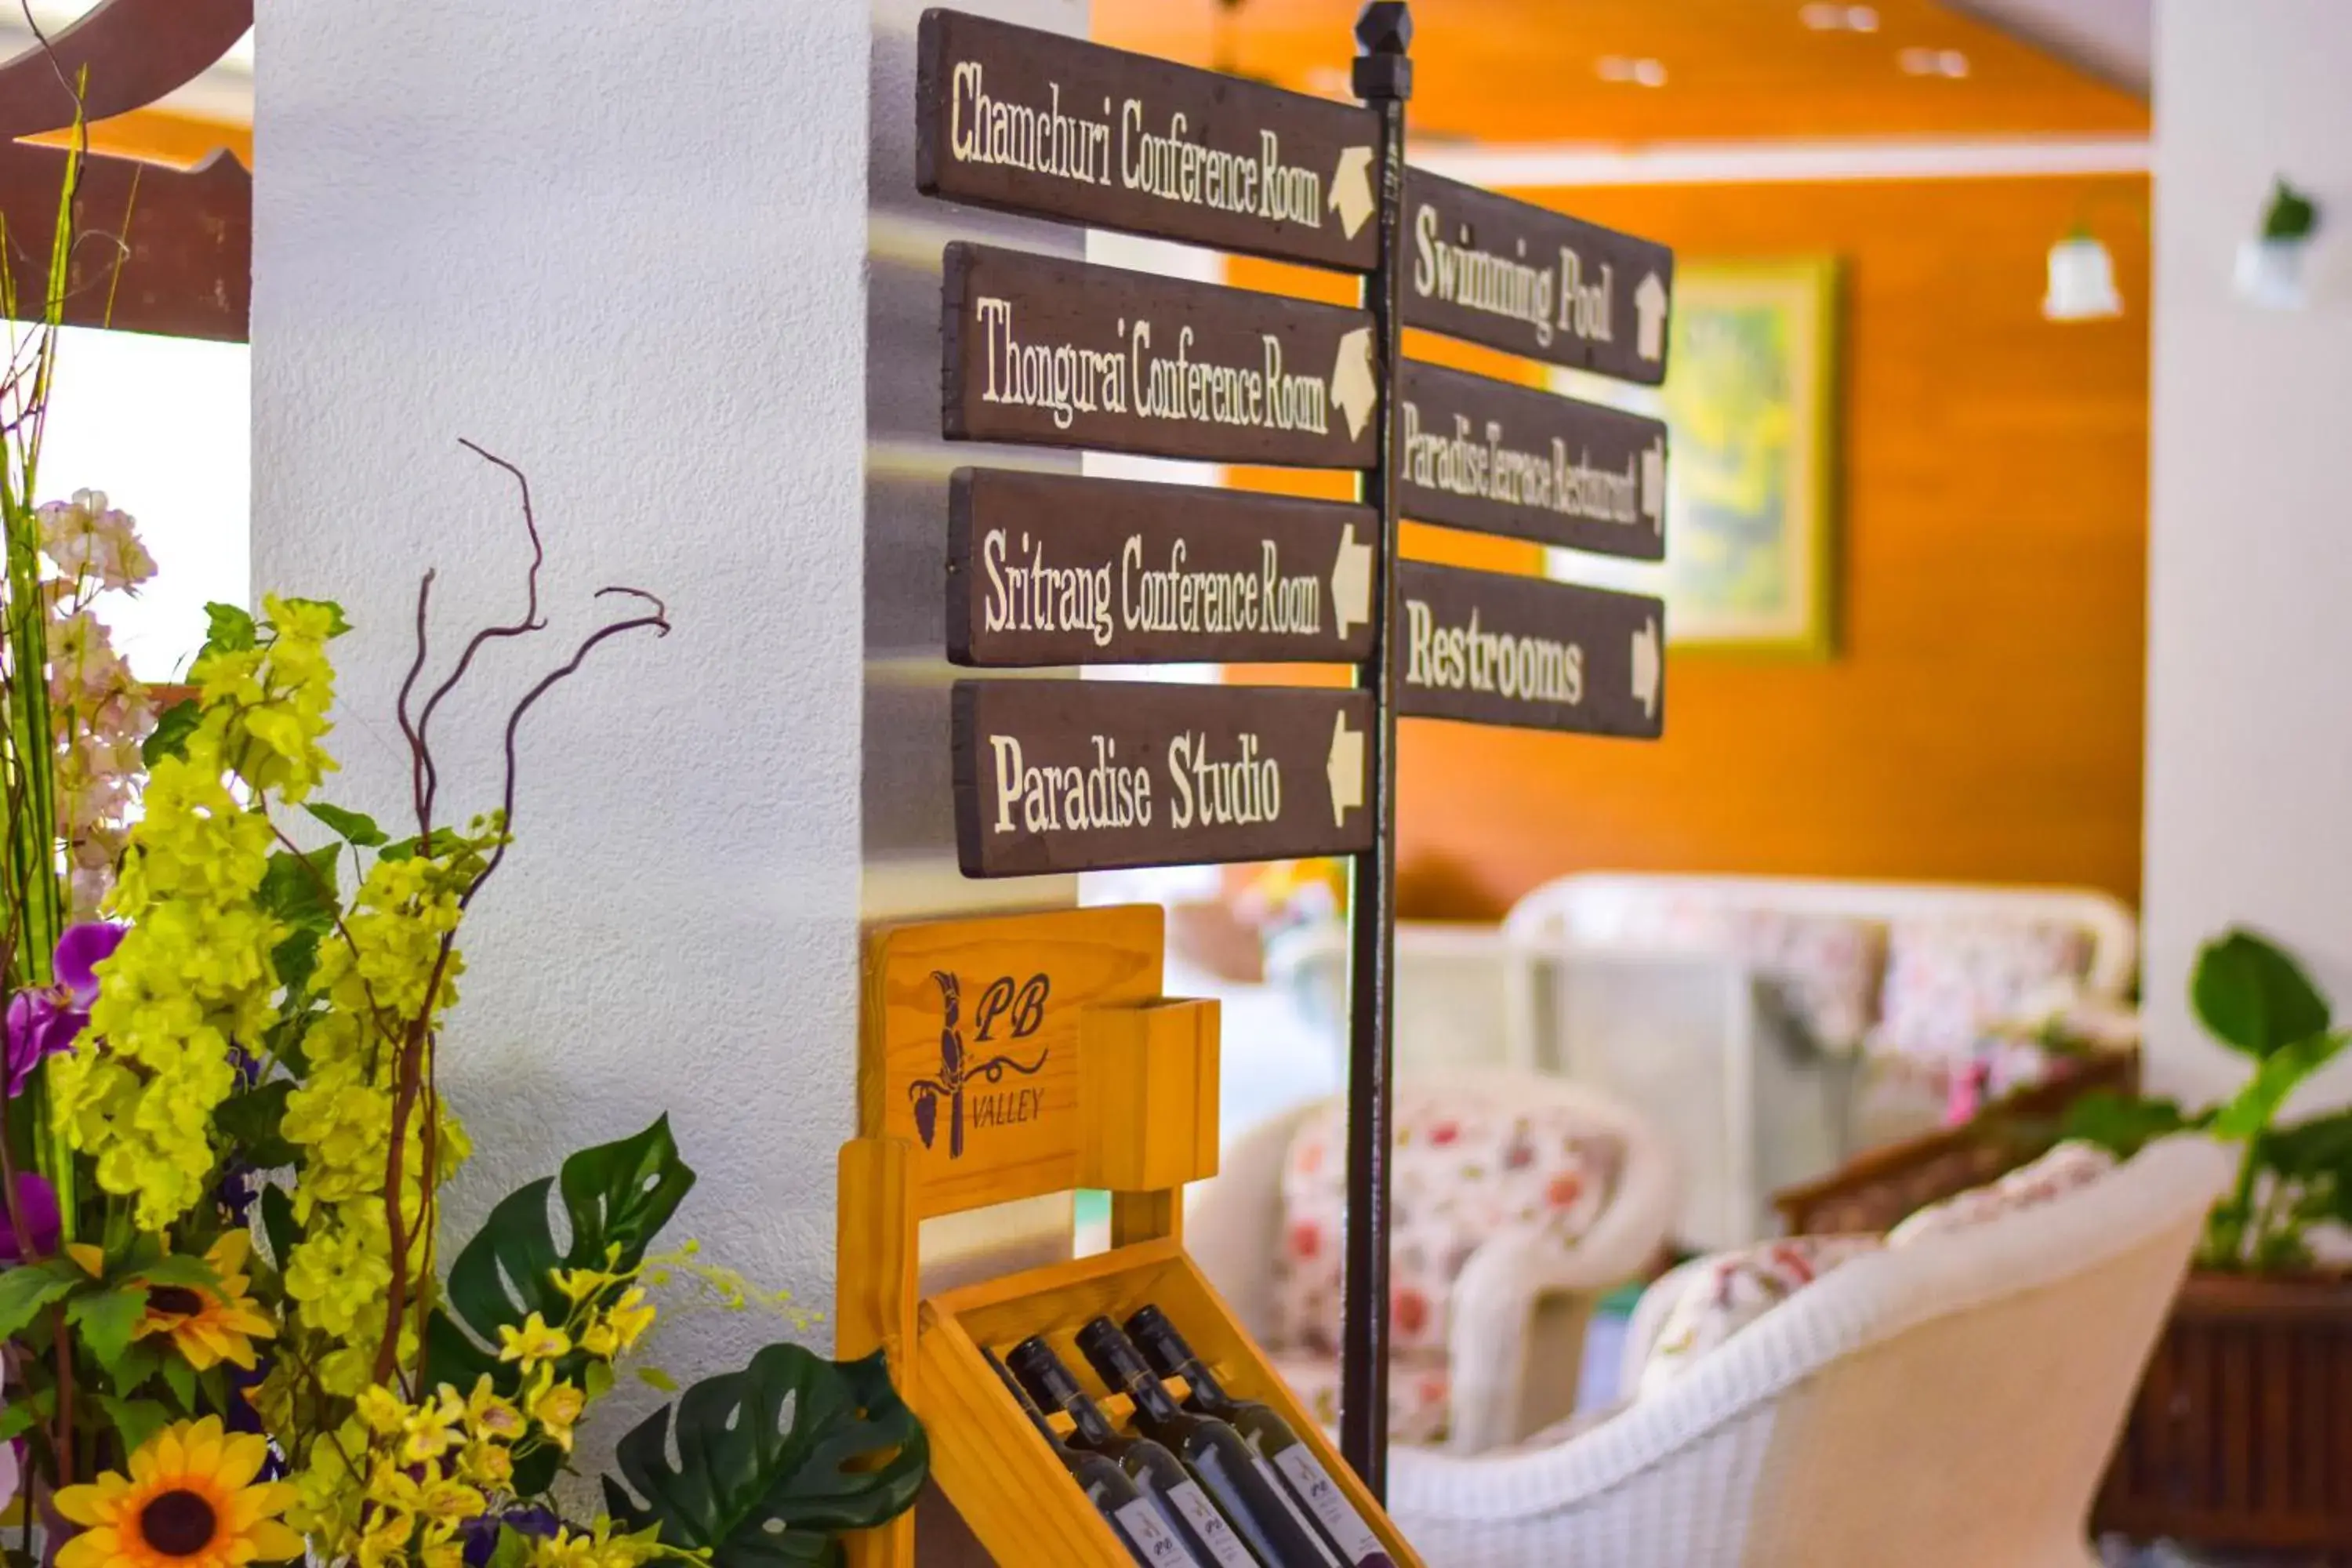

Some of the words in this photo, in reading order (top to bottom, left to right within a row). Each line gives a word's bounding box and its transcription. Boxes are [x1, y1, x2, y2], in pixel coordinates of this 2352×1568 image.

[951, 61, 1111, 186] Chamchuri
[1121, 99, 1257, 215] Conference
[1259, 129, 1322, 228] Room
[1414, 204, 1553, 347] Swimming
[1557, 245, 1613, 342] Pool
[977, 296, 1127, 430] Thongurai
[1133, 320, 1261, 428] Conference
[1263, 335, 1328, 434] Room
[1401, 401, 1488, 498] Paradise
[1485, 420, 1551, 510] Terrace
[984, 528, 1113, 647] Sritrang
[1122, 534, 1258, 633] Conference
[1259, 539, 1321, 634] Room
[1405, 599, 1583, 706] Restrooms
[989, 735, 1152, 834] Paradise
[1168, 729, 1281, 829] Studio
[973, 972, 1051, 1042] PB
[972, 1087, 1045, 1129] VALLEY
